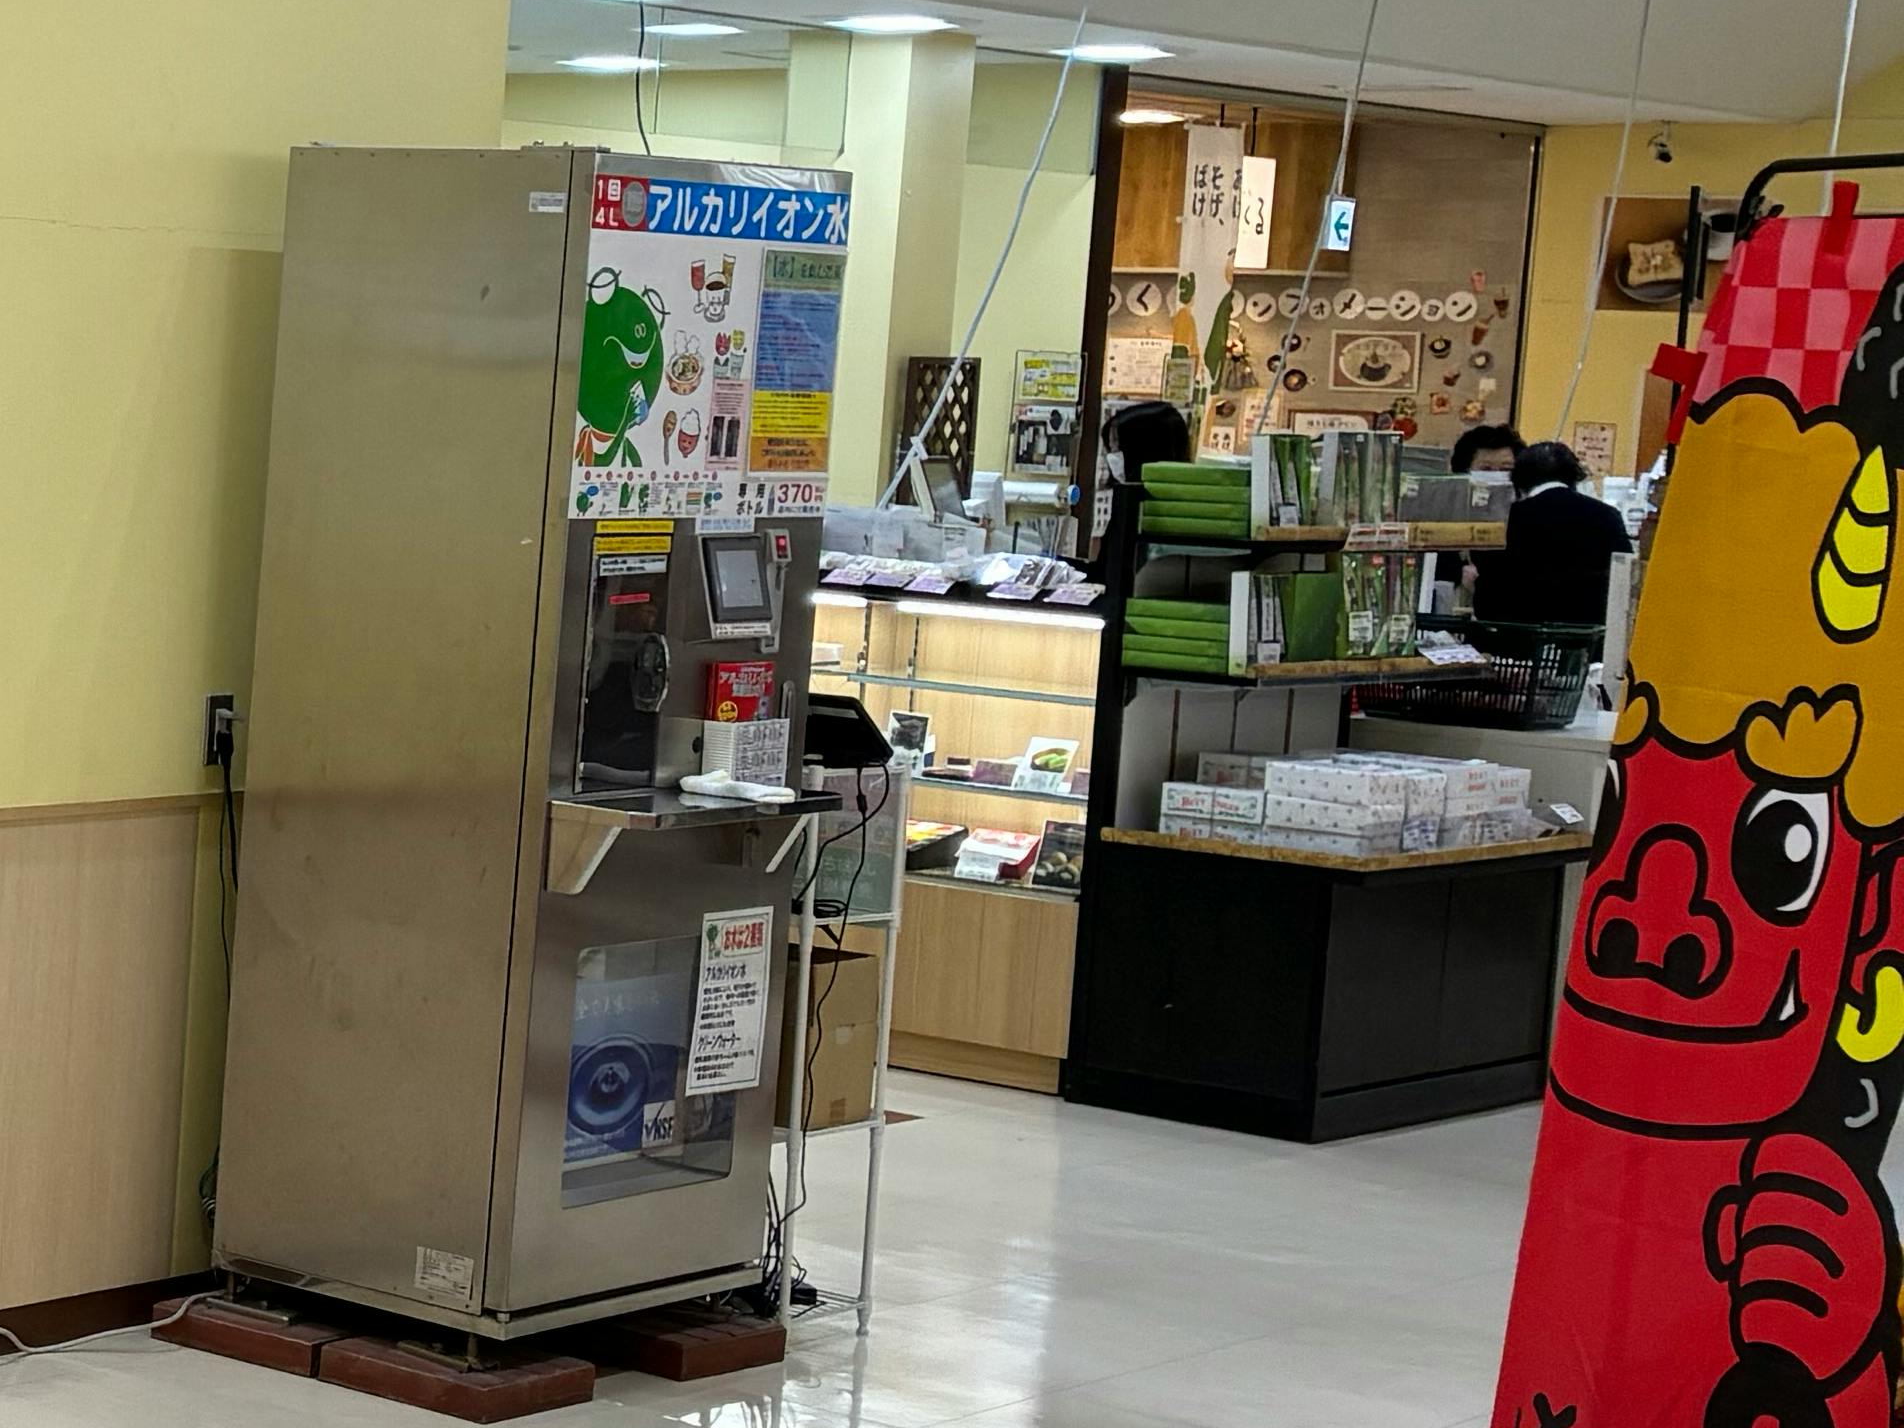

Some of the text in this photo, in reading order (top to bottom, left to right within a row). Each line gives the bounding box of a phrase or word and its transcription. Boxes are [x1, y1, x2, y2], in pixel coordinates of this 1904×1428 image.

[597, 179, 622, 201] 1回
[595, 206, 619, 227] 4L
[648, 184, 849, 245] アルカリイオン水
[777, 483, 813, 504] 370
